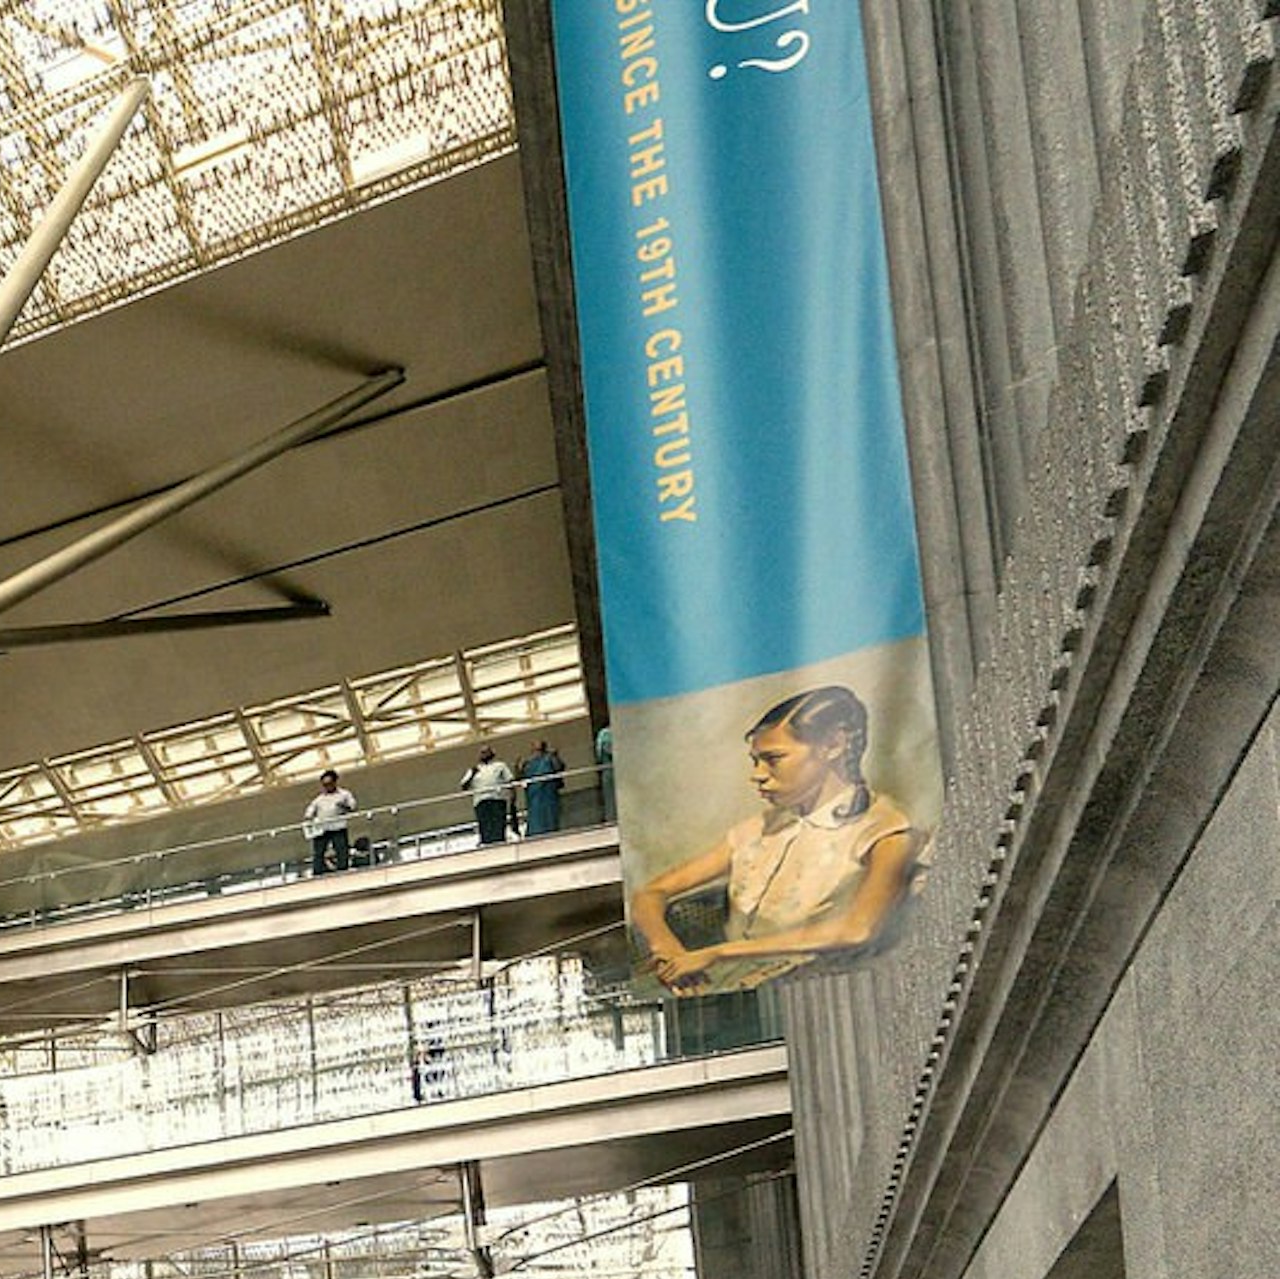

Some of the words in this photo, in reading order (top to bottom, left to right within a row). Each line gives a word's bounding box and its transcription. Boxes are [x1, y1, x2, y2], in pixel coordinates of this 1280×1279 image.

[628, 118, 670, 207] THE
[636, 217, 678, 317] 19TH
[644, 328, 697, 524] CENTURY
